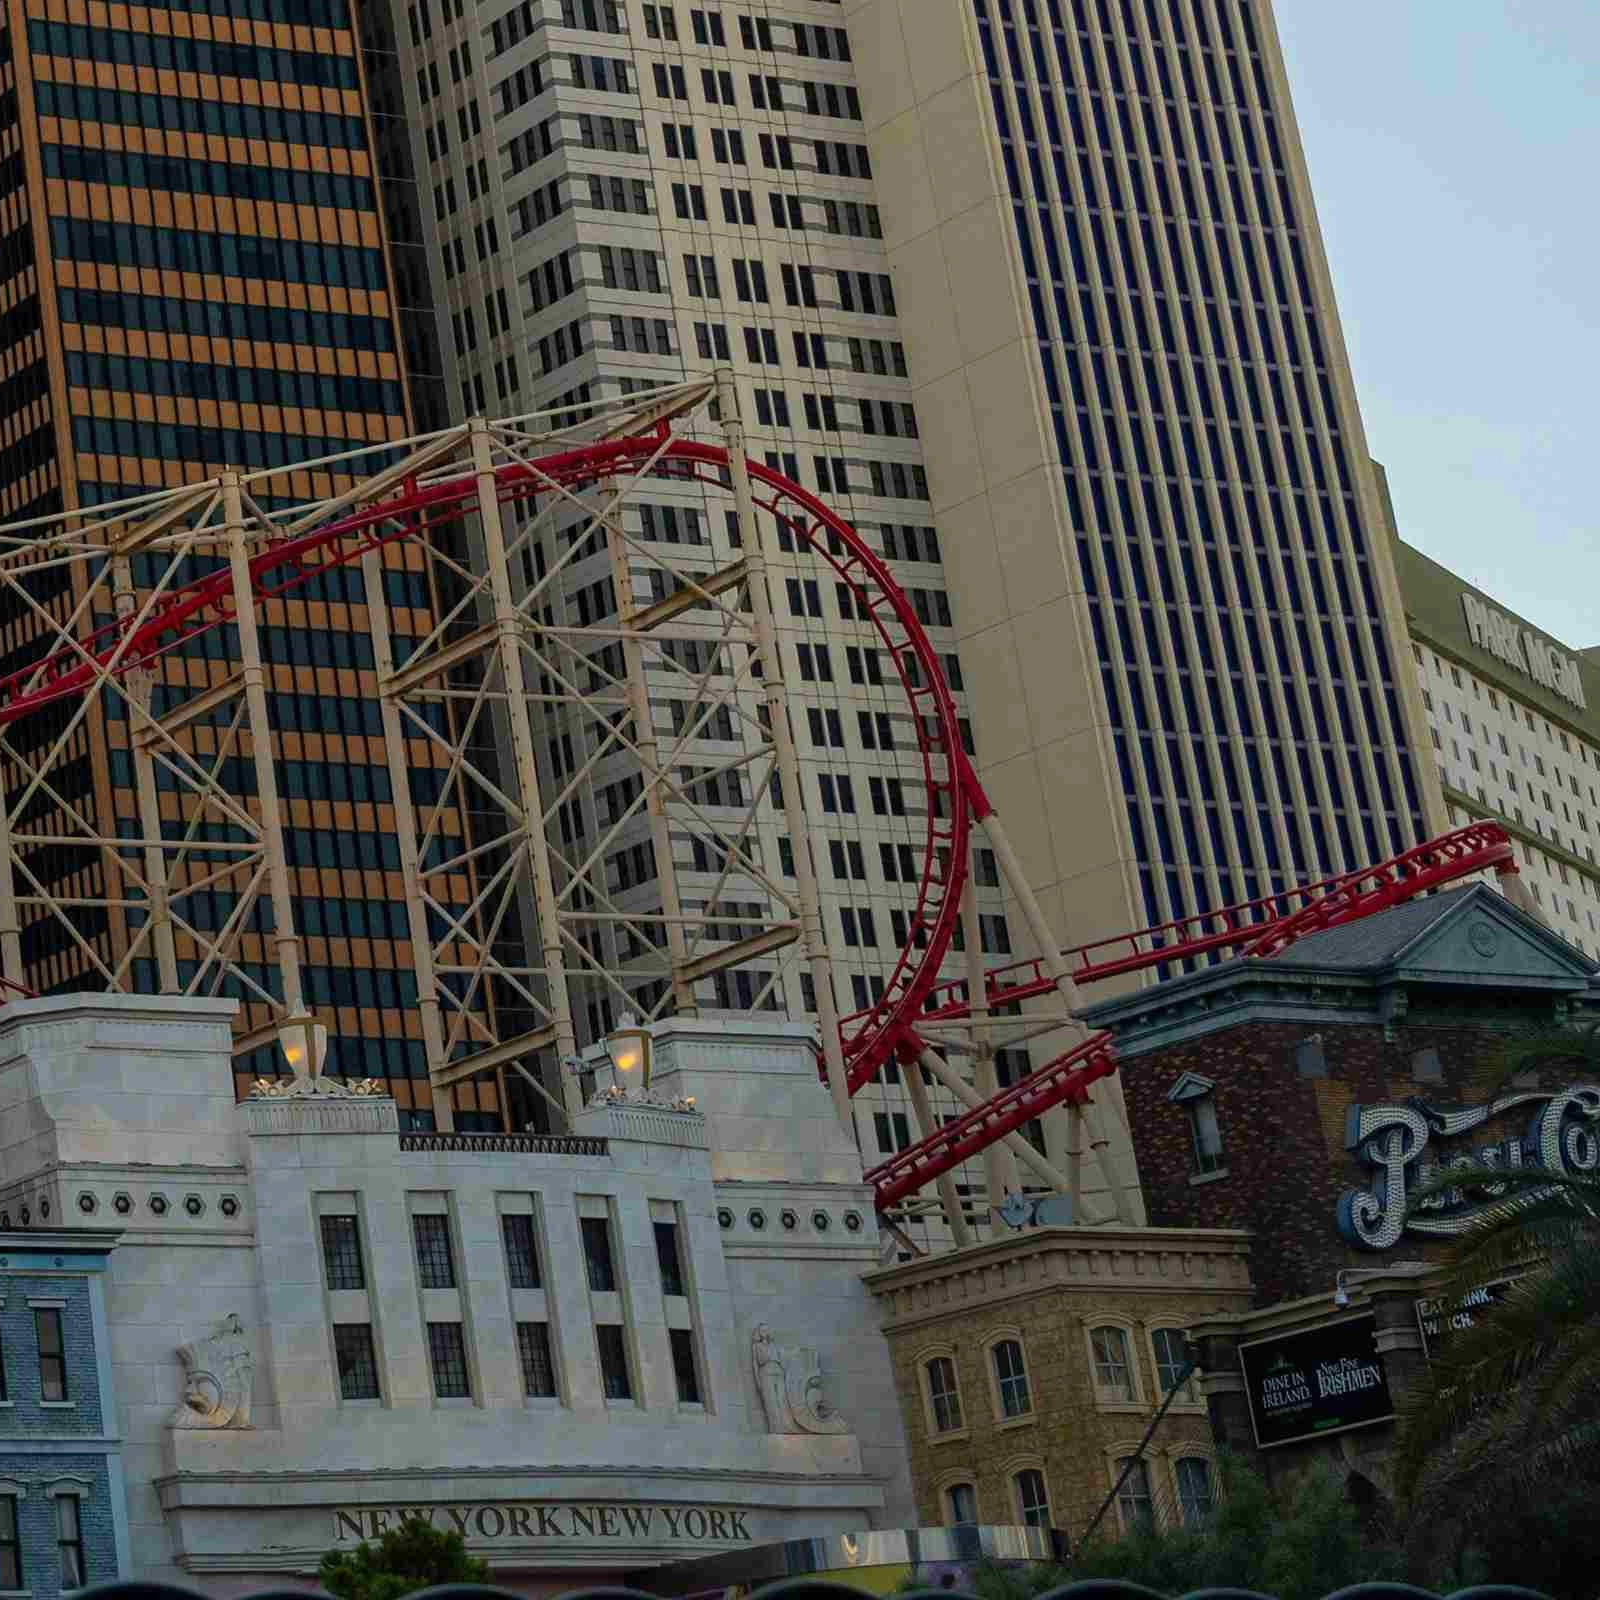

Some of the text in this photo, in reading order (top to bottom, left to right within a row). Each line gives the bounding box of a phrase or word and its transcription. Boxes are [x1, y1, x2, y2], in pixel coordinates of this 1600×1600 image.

[448, 1506, 564, 1538] YORK
[571, 1506, 656, 1537] NEW
[660, 1509, 753, 1541] YORK
